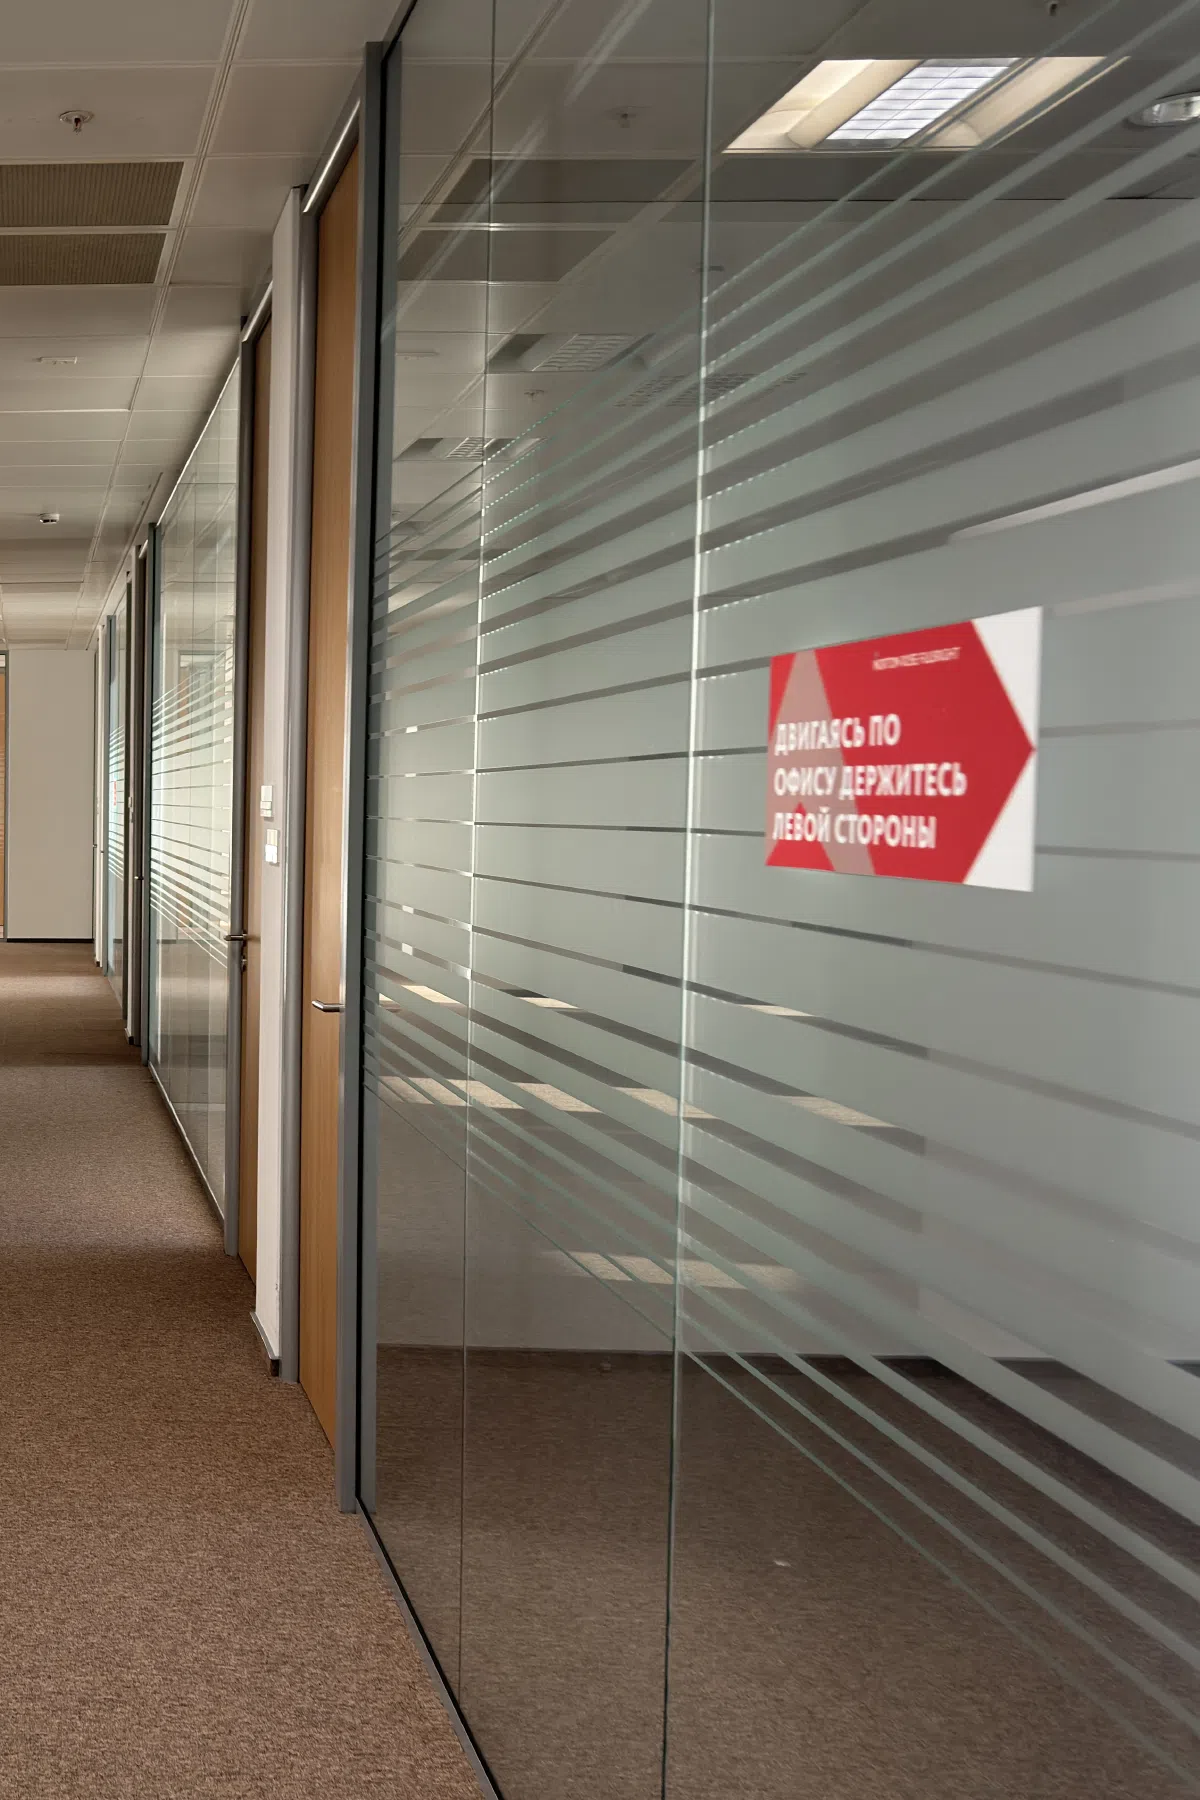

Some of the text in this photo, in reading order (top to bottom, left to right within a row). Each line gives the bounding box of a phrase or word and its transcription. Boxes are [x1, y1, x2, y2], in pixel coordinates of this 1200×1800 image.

[774, 714, 901, 756] ДВИГАЯСЬ ПО
[773, 762, 968, 800] ОФИСУ ДЕРЖИТЕСЬ
[772, 806, 937, 849] ЛЕВОЙ СТОРОНЫ
